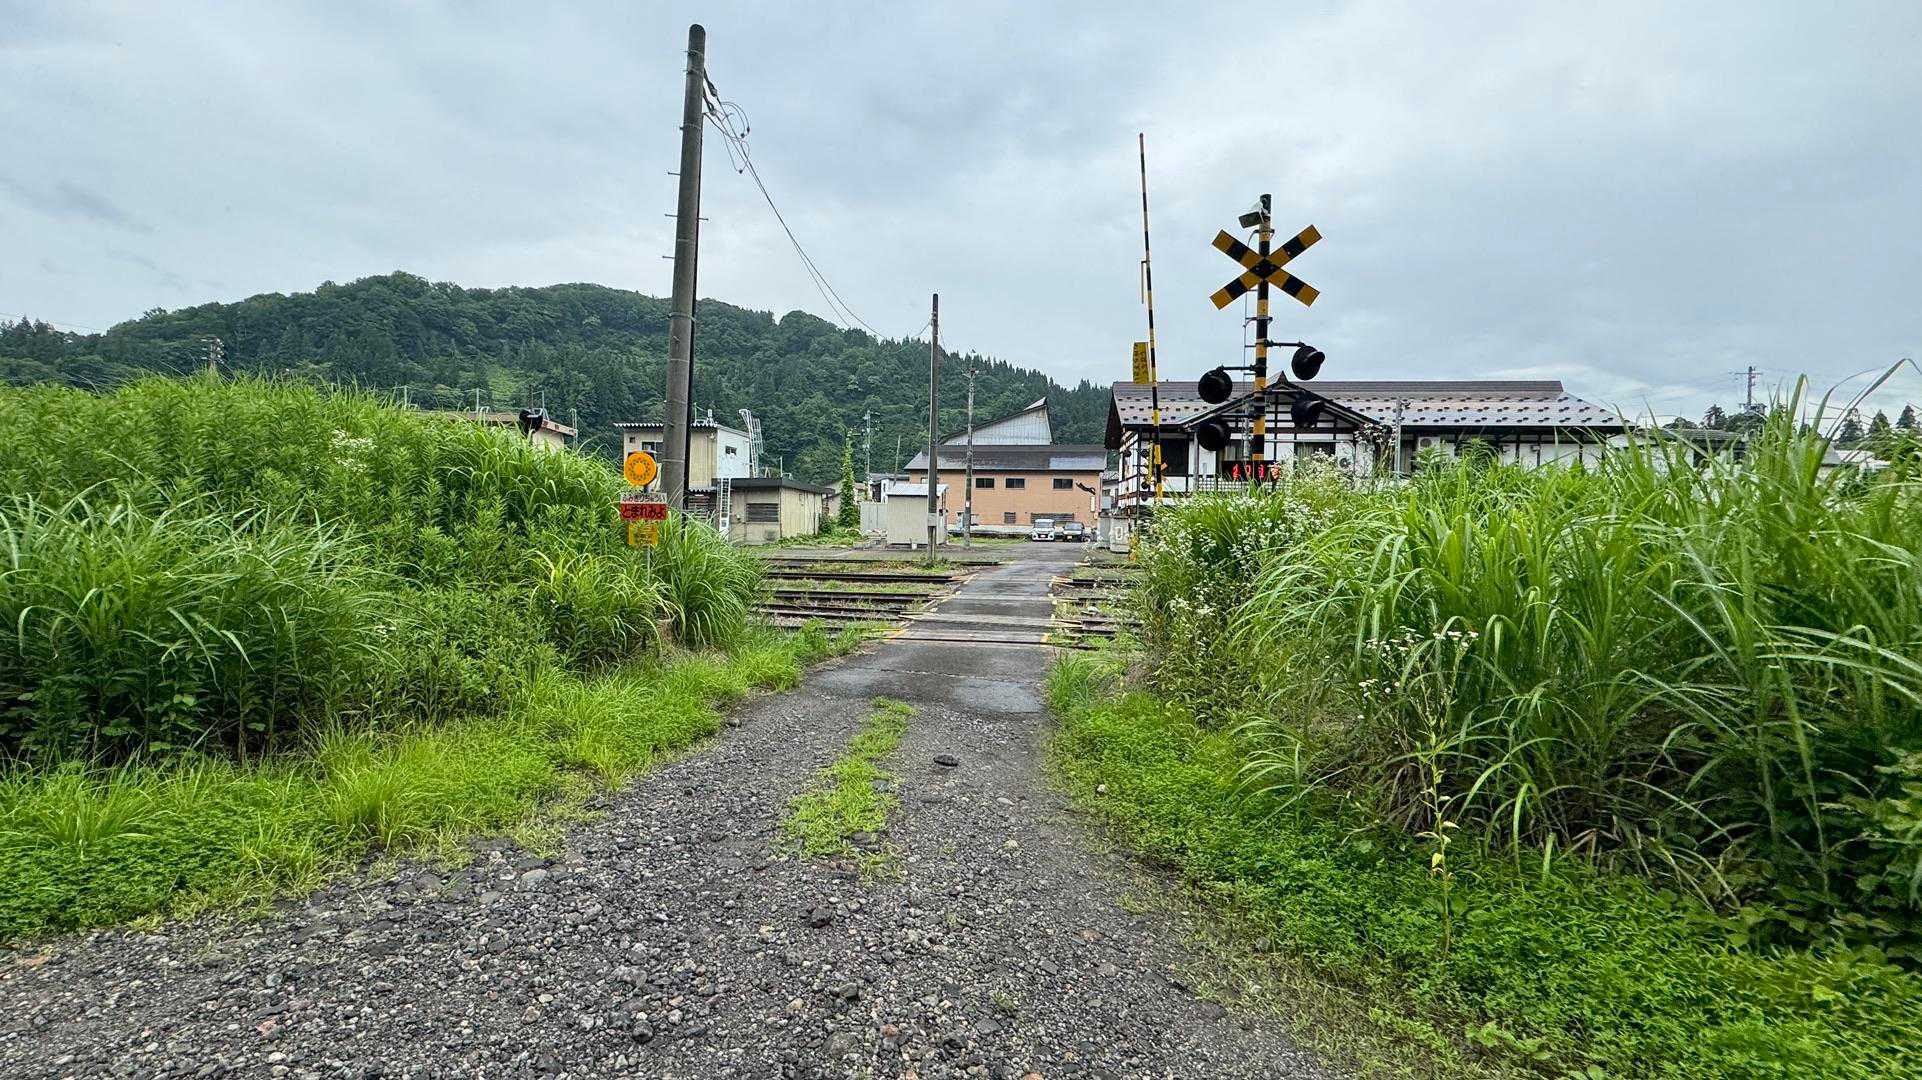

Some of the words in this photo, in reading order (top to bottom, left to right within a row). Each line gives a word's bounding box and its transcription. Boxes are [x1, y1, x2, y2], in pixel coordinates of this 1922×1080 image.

[621, 504, 666, 519] とまれみよ
